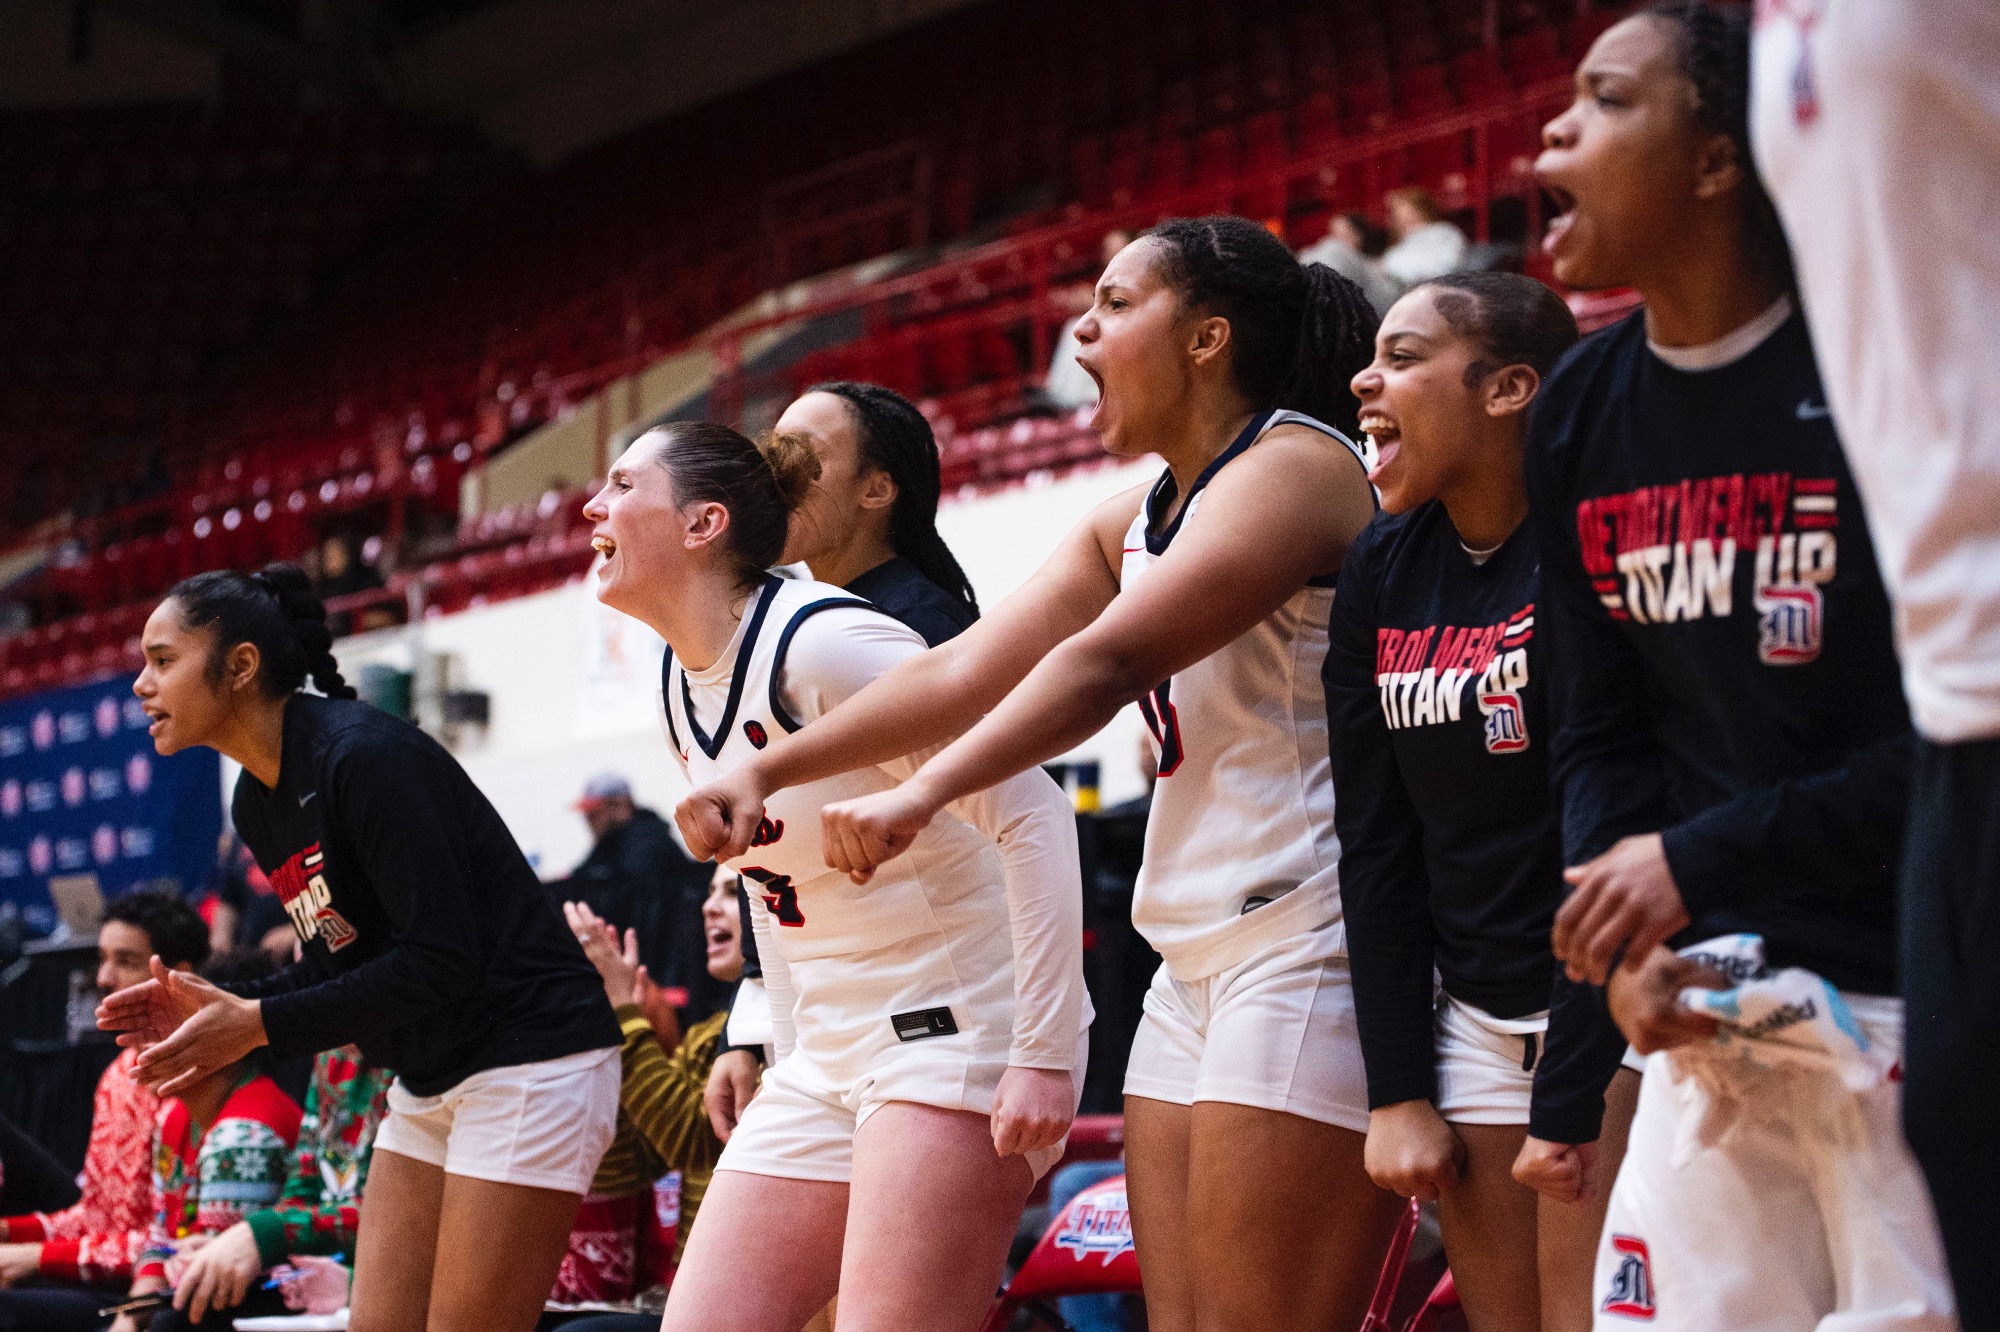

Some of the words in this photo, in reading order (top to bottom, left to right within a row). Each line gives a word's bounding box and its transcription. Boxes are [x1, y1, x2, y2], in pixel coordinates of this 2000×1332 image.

[1616, 536, 1737, 625] TITAN
[1752, 530, 1838, 613] UP
[1377, 666, 1473, 730] TITAN
[1476, 646, 1529, 716] UP
[935, 1016, 945, 1028] L
